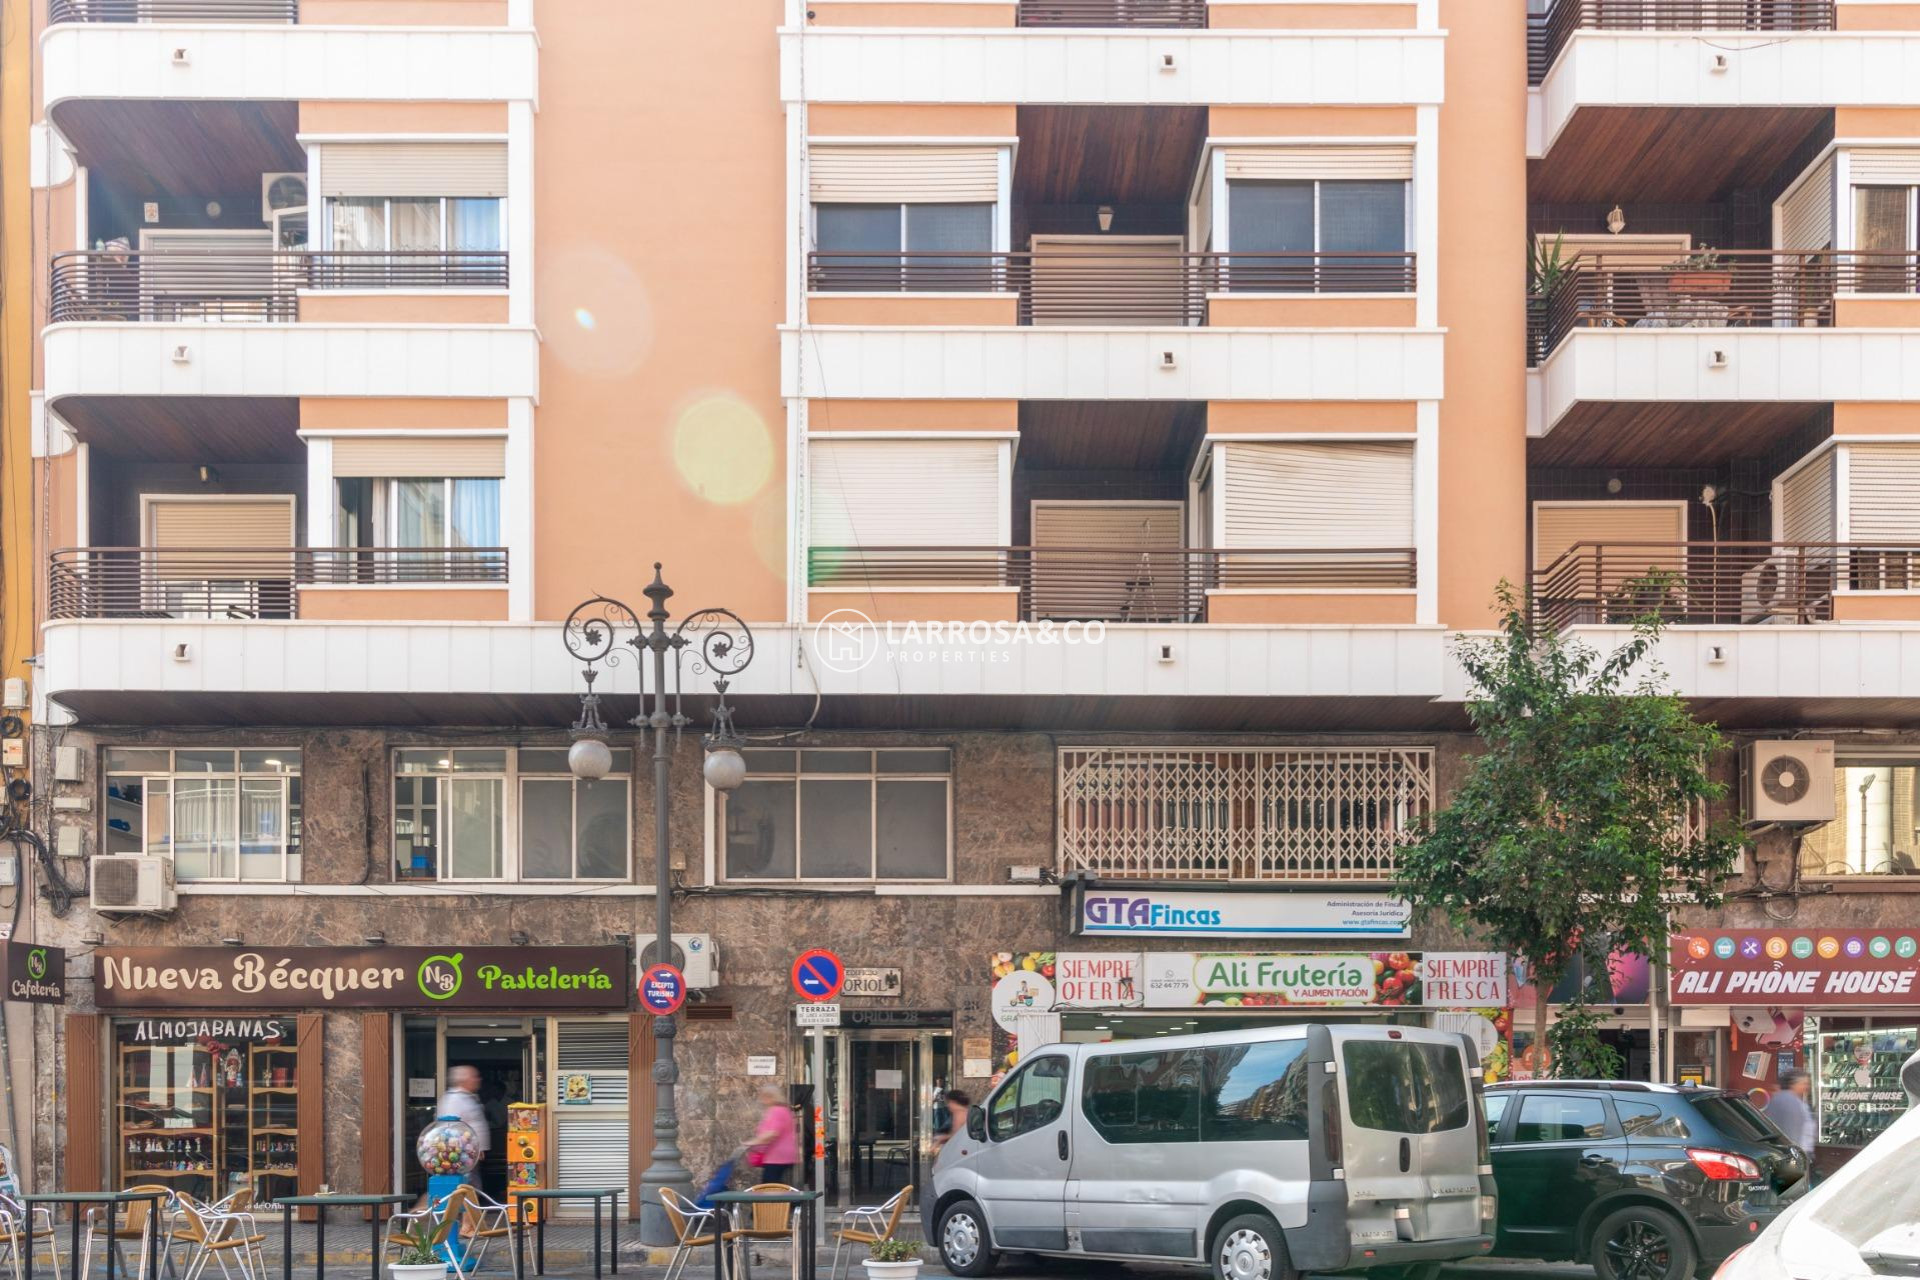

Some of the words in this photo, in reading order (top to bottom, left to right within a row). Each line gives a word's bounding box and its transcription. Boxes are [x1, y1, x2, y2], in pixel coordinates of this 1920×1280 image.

[103, 956, 223, 990] Nueva
[231, 953, 405, 1000] Bécquer
[477, 964, 612, 990] Pastelería
[1062, 960, 1135, 979] SIEMPRE
[1207, 962, 1249, 987] Ali
[1258, 961, 1362, 987] Frutería
[1427, 959, 1500, 979] SIEMPRE
[12, 979, 61, 999] Cafetería
[650, 981, 674, 989] EXCEPTO
[844, 979, 887, 992] ORIOL
[1062, 981, 1135, 1001] OFERTA
[1427, 981, 1500, 1000] FRESCA
[1678, 971, 1723, 994] ALI
[1725, 971, 1821, 994] PHONE
[1824, 971, 1917, 994] HOUSE
[647, 990, 675, 998] TURISMO
[1293, 989, 1300, 997] Y
[852, 1011, 896, 1023] ORIOL
[902, 1011, 919, 1023] 28
[1837, 1091, 1871, 1101] PHONE
[1872, 1091, 1904, 1101] HOUSE
[1837, 1103, 1856, 1111] 600
